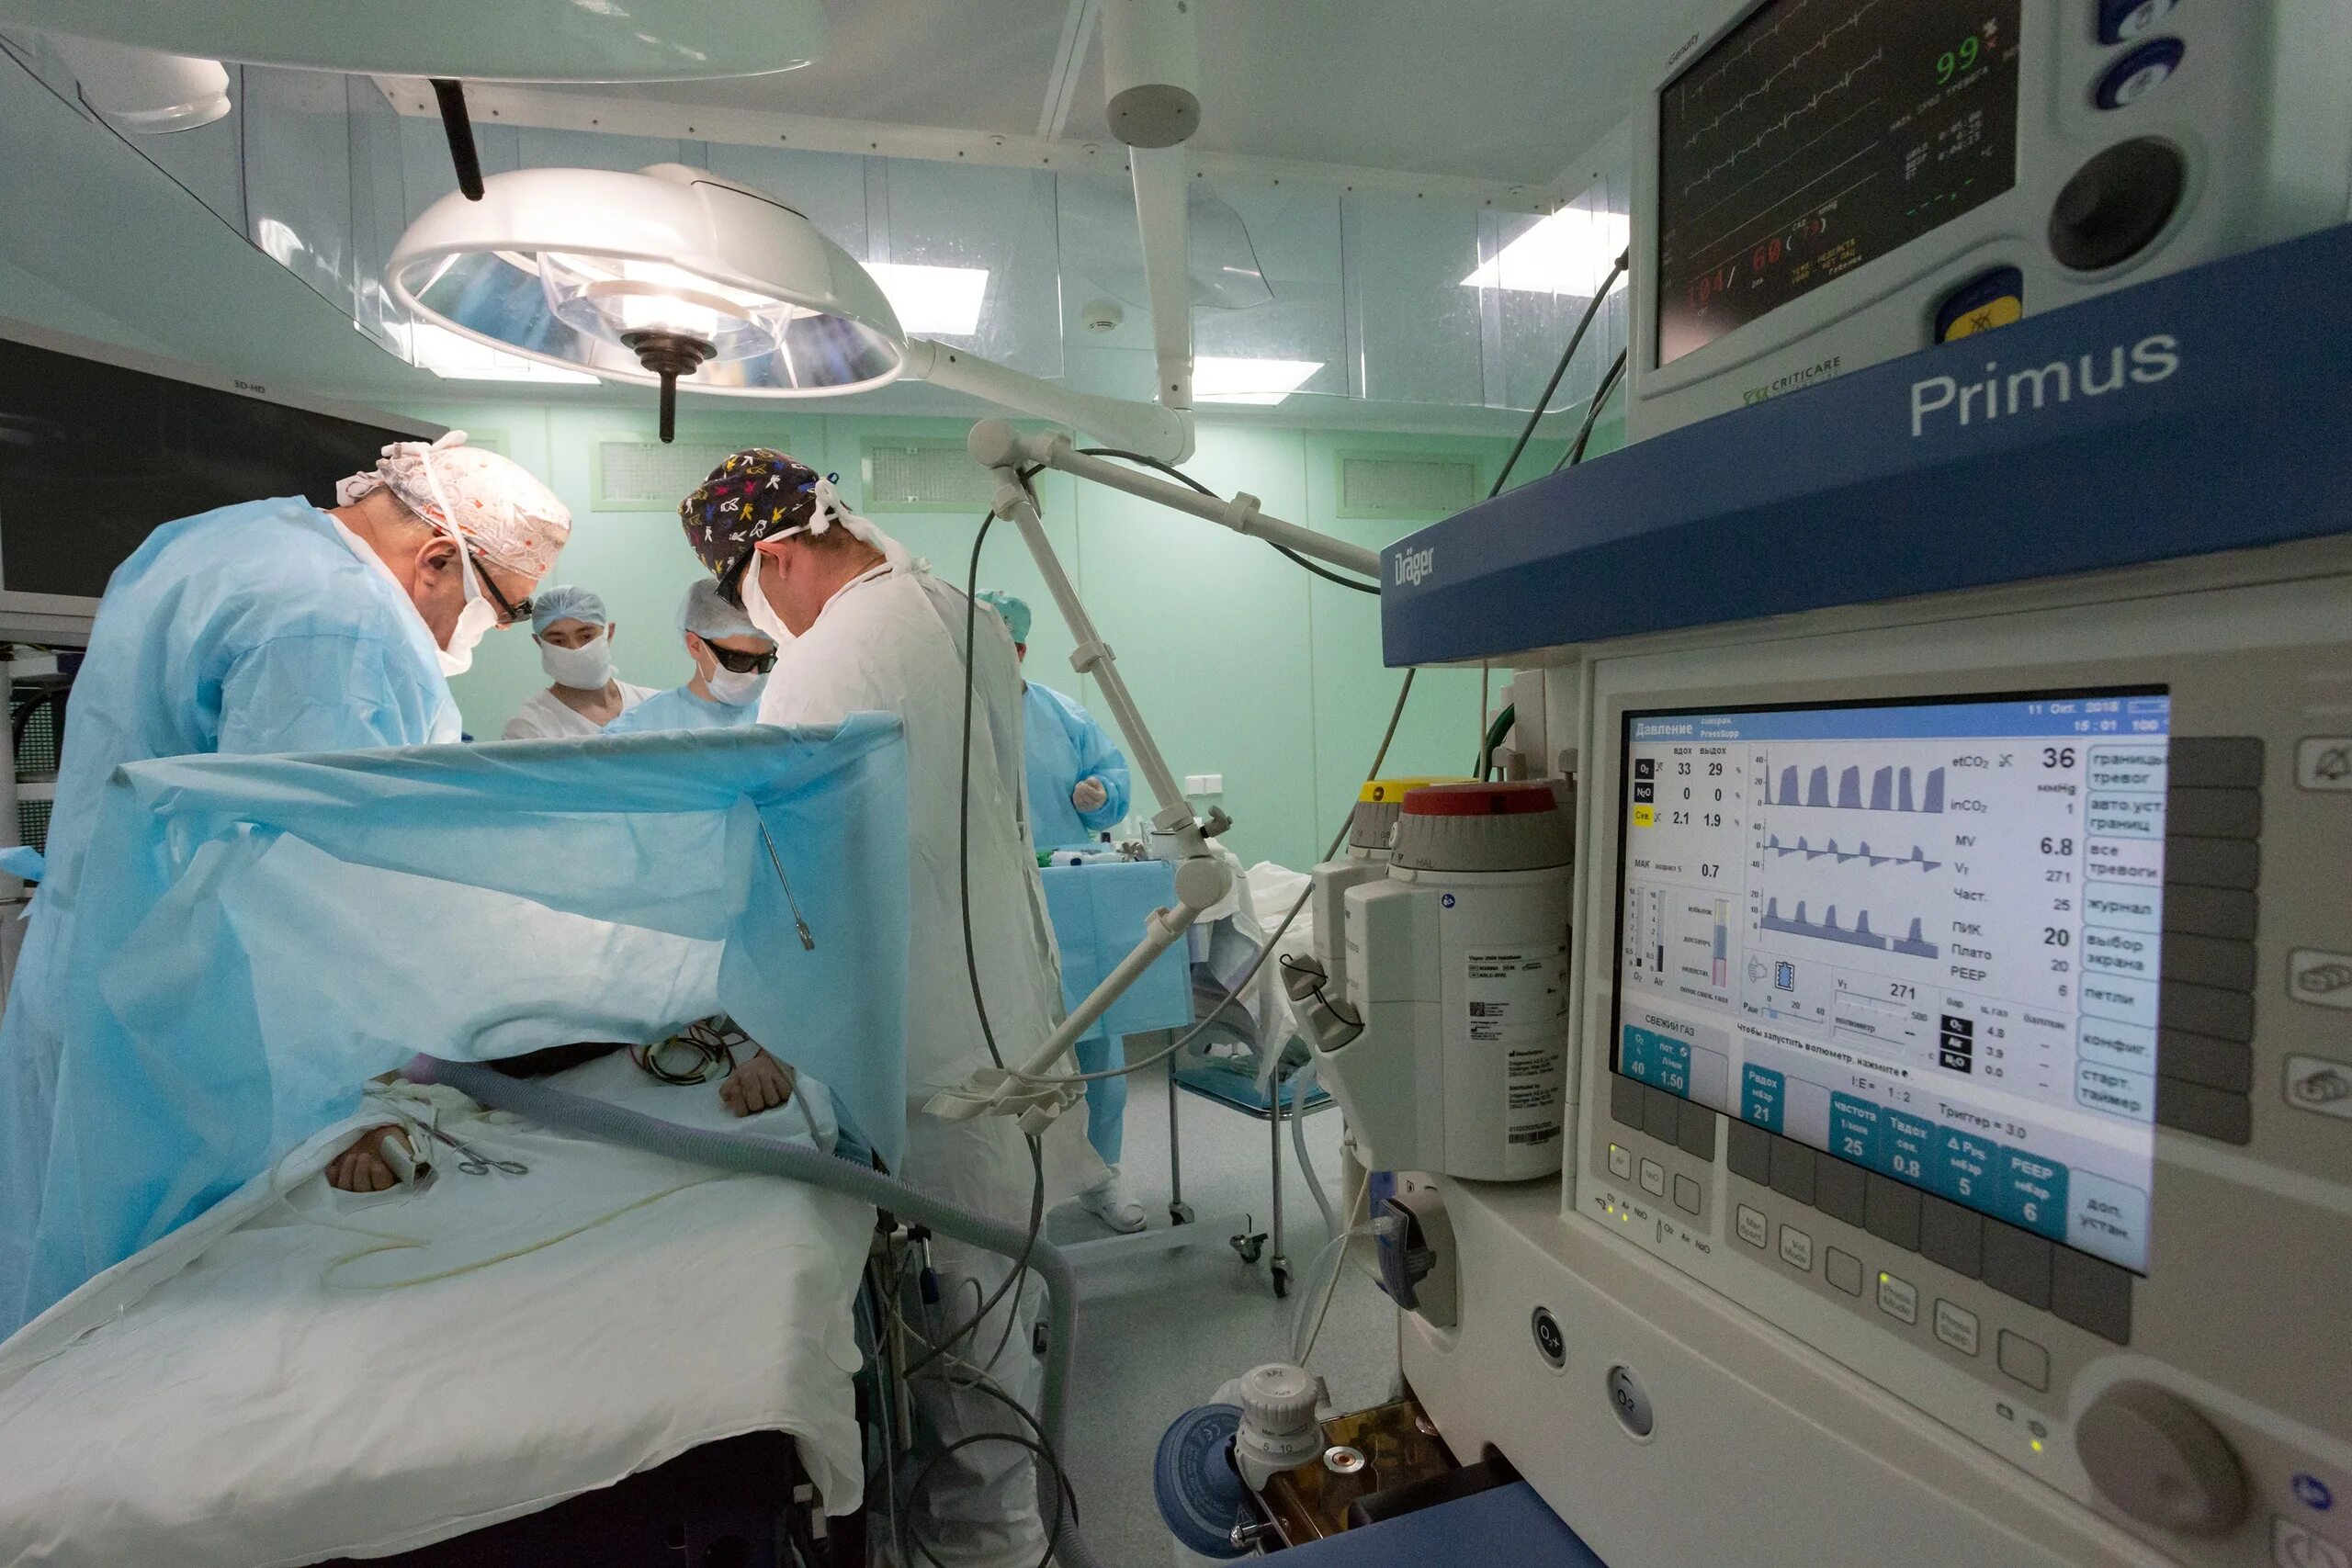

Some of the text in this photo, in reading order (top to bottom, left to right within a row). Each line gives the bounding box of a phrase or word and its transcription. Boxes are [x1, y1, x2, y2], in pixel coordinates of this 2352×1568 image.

[1936, 35, 1980, 85] 99
[1771, 356, 1842, 391] CRITICARE
[233, 379, 266, 394] 3D-HD
[1911, 333, 2179, 437] Primus
[1395, 547, 1434, 586] Dräger
[1635, 722, 1694, 739] Давление
[1673, 747, 1727, 756] вдох выдох
[2042, 748, 2075, 769] 36
[1678, 762, 1692, 776] 33
[1708, 762, 1724, 776] 29
[2093, 773, 2151, 784] тревог
[1683, 787, 1691, 801] 0
[1714, 788, 1723, 802] 0
[2067, 804, 2074, 815] 1
[1673, 811, 1690, 825] 2.1
[1703, 813, 1722, 828] 1.9
[2090, 818, 2151, 831] границ
[1955, 835, 2074, 857] MV 6.8
[2090, 845, 2119, 856] все
[1702, 863, 1720, 878] 0.7
[2045, 870, 2071, 883] 271
[2089, 863, 2158, 878] тревоги
[2053, 898, 2071, 911] 25
[2087, 898, 2153, 916] журнал
[2043, 928, 2069, 947] 20
[2086, 934, 2144, 953] выбор
[1951, 943, 2069, 972] Плато 20
[2086, 953, 2145, 972] экрана
[1951, 966, 2068, 997] PEEP 6
[1890, 983, 1917, 1000] 271
[2085, 987, 2134, 1005] петли
[1679, 1023, 1695, 1036] ГАЗ
[1764, 1031, 1804, 1049] запустить
[1857, 1059, 1900, 1077] нажмите
[1632, 1061, 1645, 1075] 40
[1660, 1071, 1683, 1089] 1.50
[1754, 1104, 1770, 1122] 21
[1938, 1102, 1991, 1130] Триггер
[2006, 1123, 2028, 1140] 3.0
[1844, 1137, 1863, 1156] 25
[1893, 1155, 1921, 1179] 0.8
[2010, 1156, 2054, 1180] PEEP
[1958, 1178, 1972, 1196] 5
[2023, 1201, 2038, 1222] 6
[1267, 1369, 1284, 1378] APL
[1617, 1388, 1635, 1412] O2
[1263, 1442, 1293, 1453] 5 10
